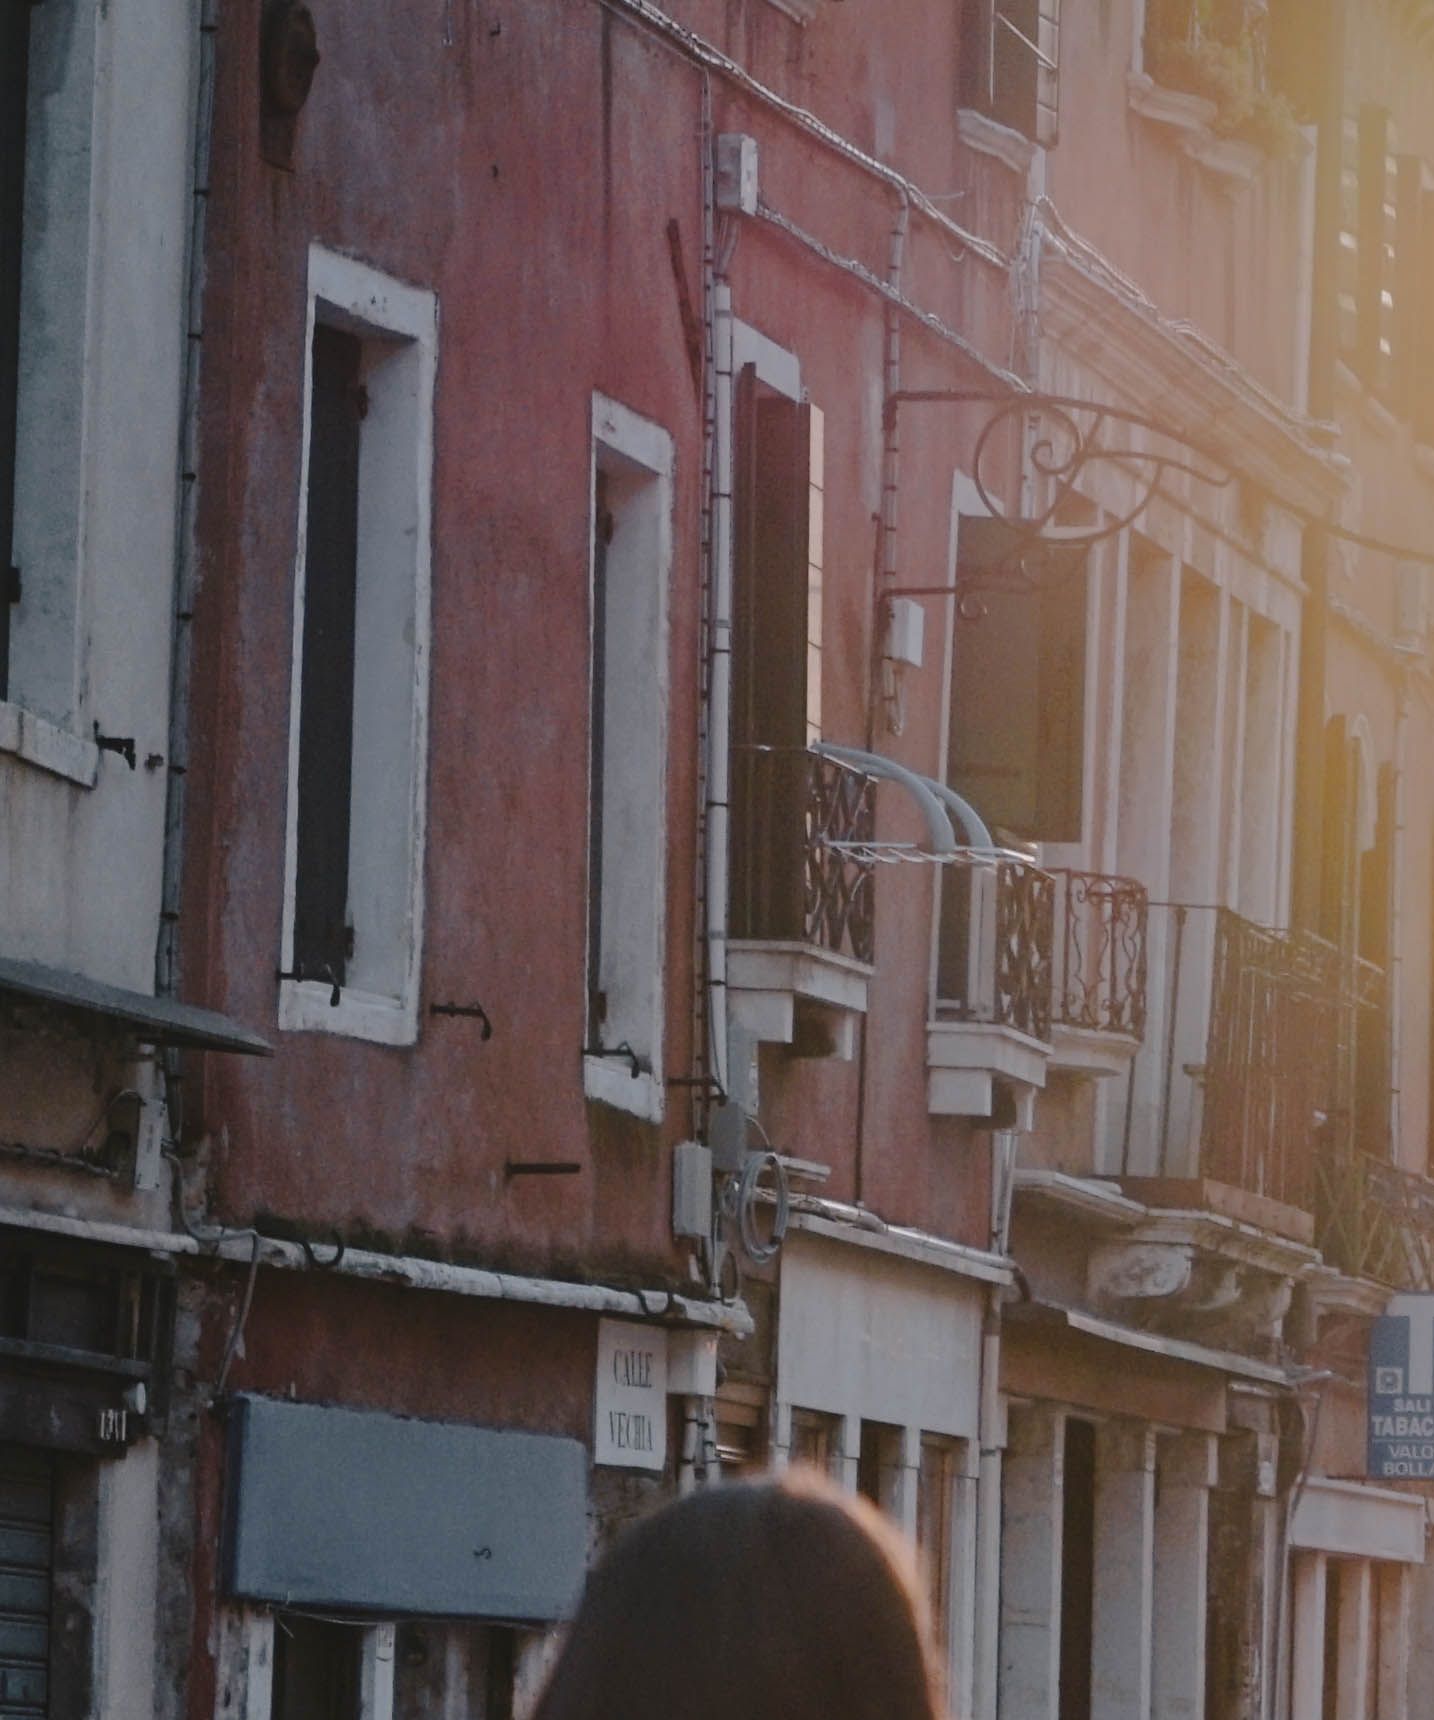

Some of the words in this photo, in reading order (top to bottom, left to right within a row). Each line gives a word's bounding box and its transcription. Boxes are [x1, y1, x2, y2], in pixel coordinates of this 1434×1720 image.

[612, 1349, 653, 1388] CALLE
[1393, 1398, 1431, 1413] SALI
[609, 1411, 653, 1451] VECHIA
